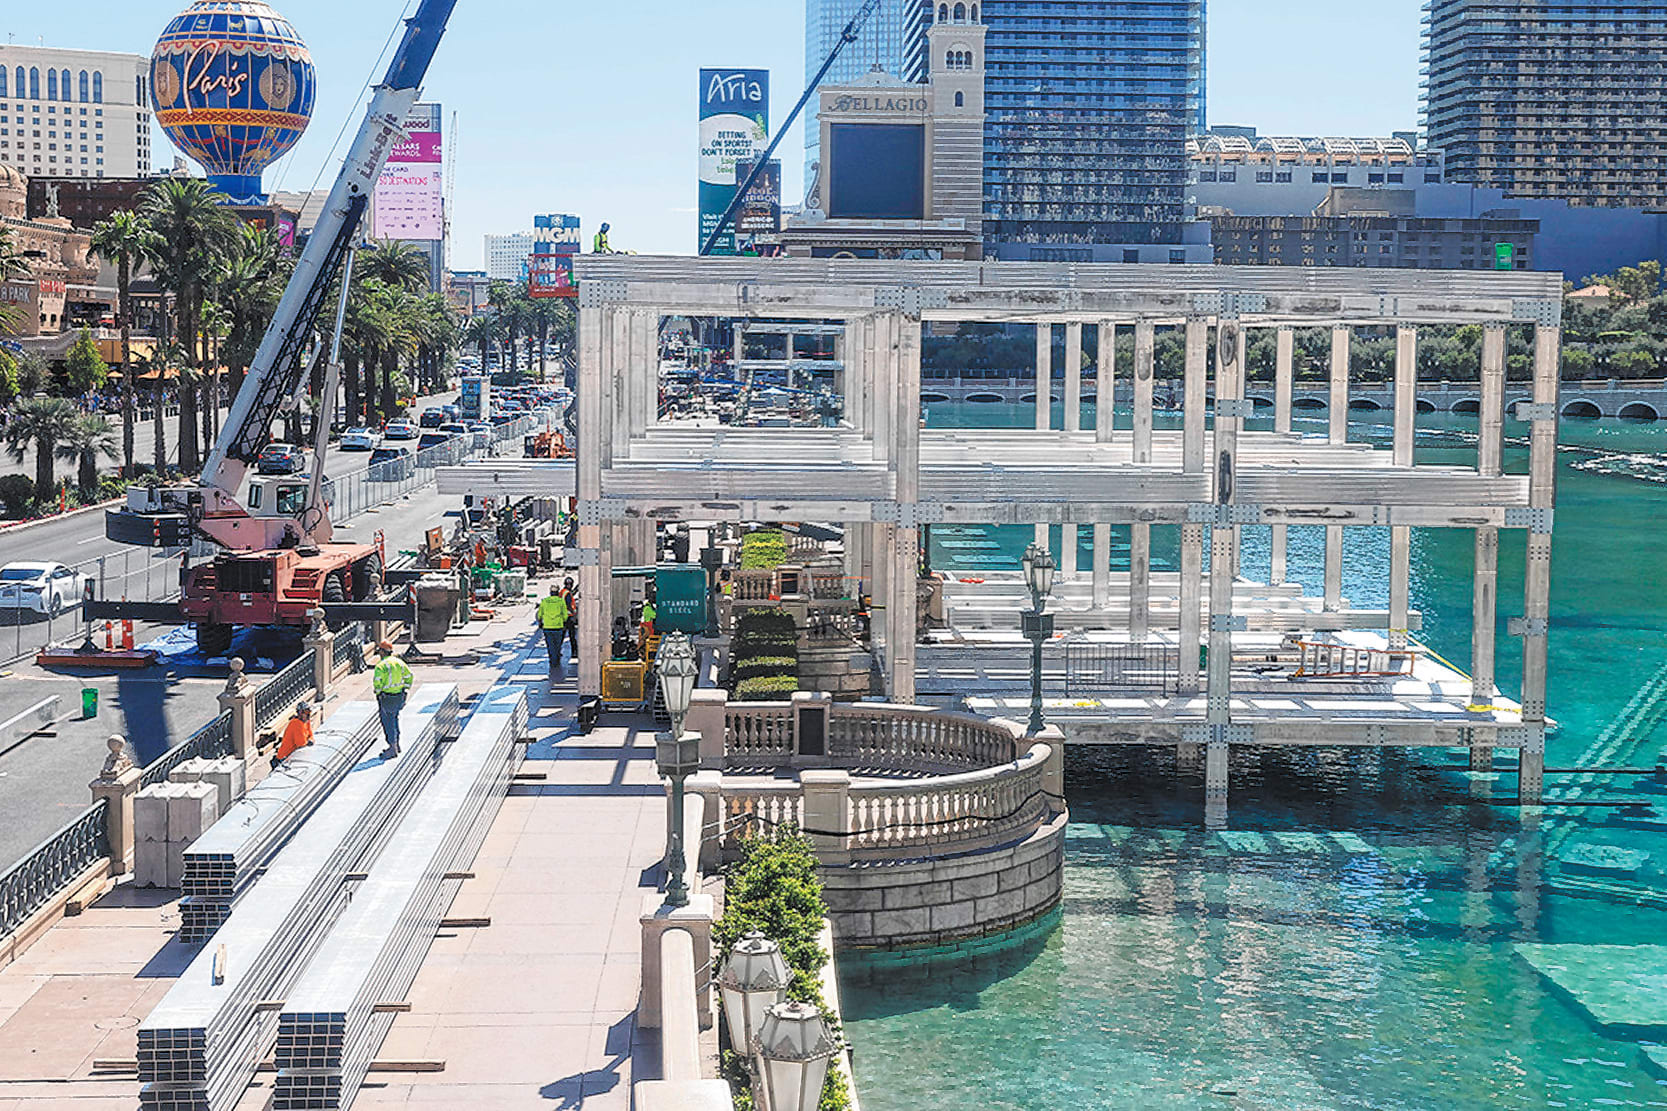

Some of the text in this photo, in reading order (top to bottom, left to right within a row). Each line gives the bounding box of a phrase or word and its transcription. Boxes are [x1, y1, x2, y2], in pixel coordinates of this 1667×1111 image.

[183, 40, 248, 115] Paris
[707, 73, 762, 104] Aria
[828, 94, 928, 112] BELLAGIO
[534, 227, 580, 243] MGM
[8, 286, 31, 304] PARK
